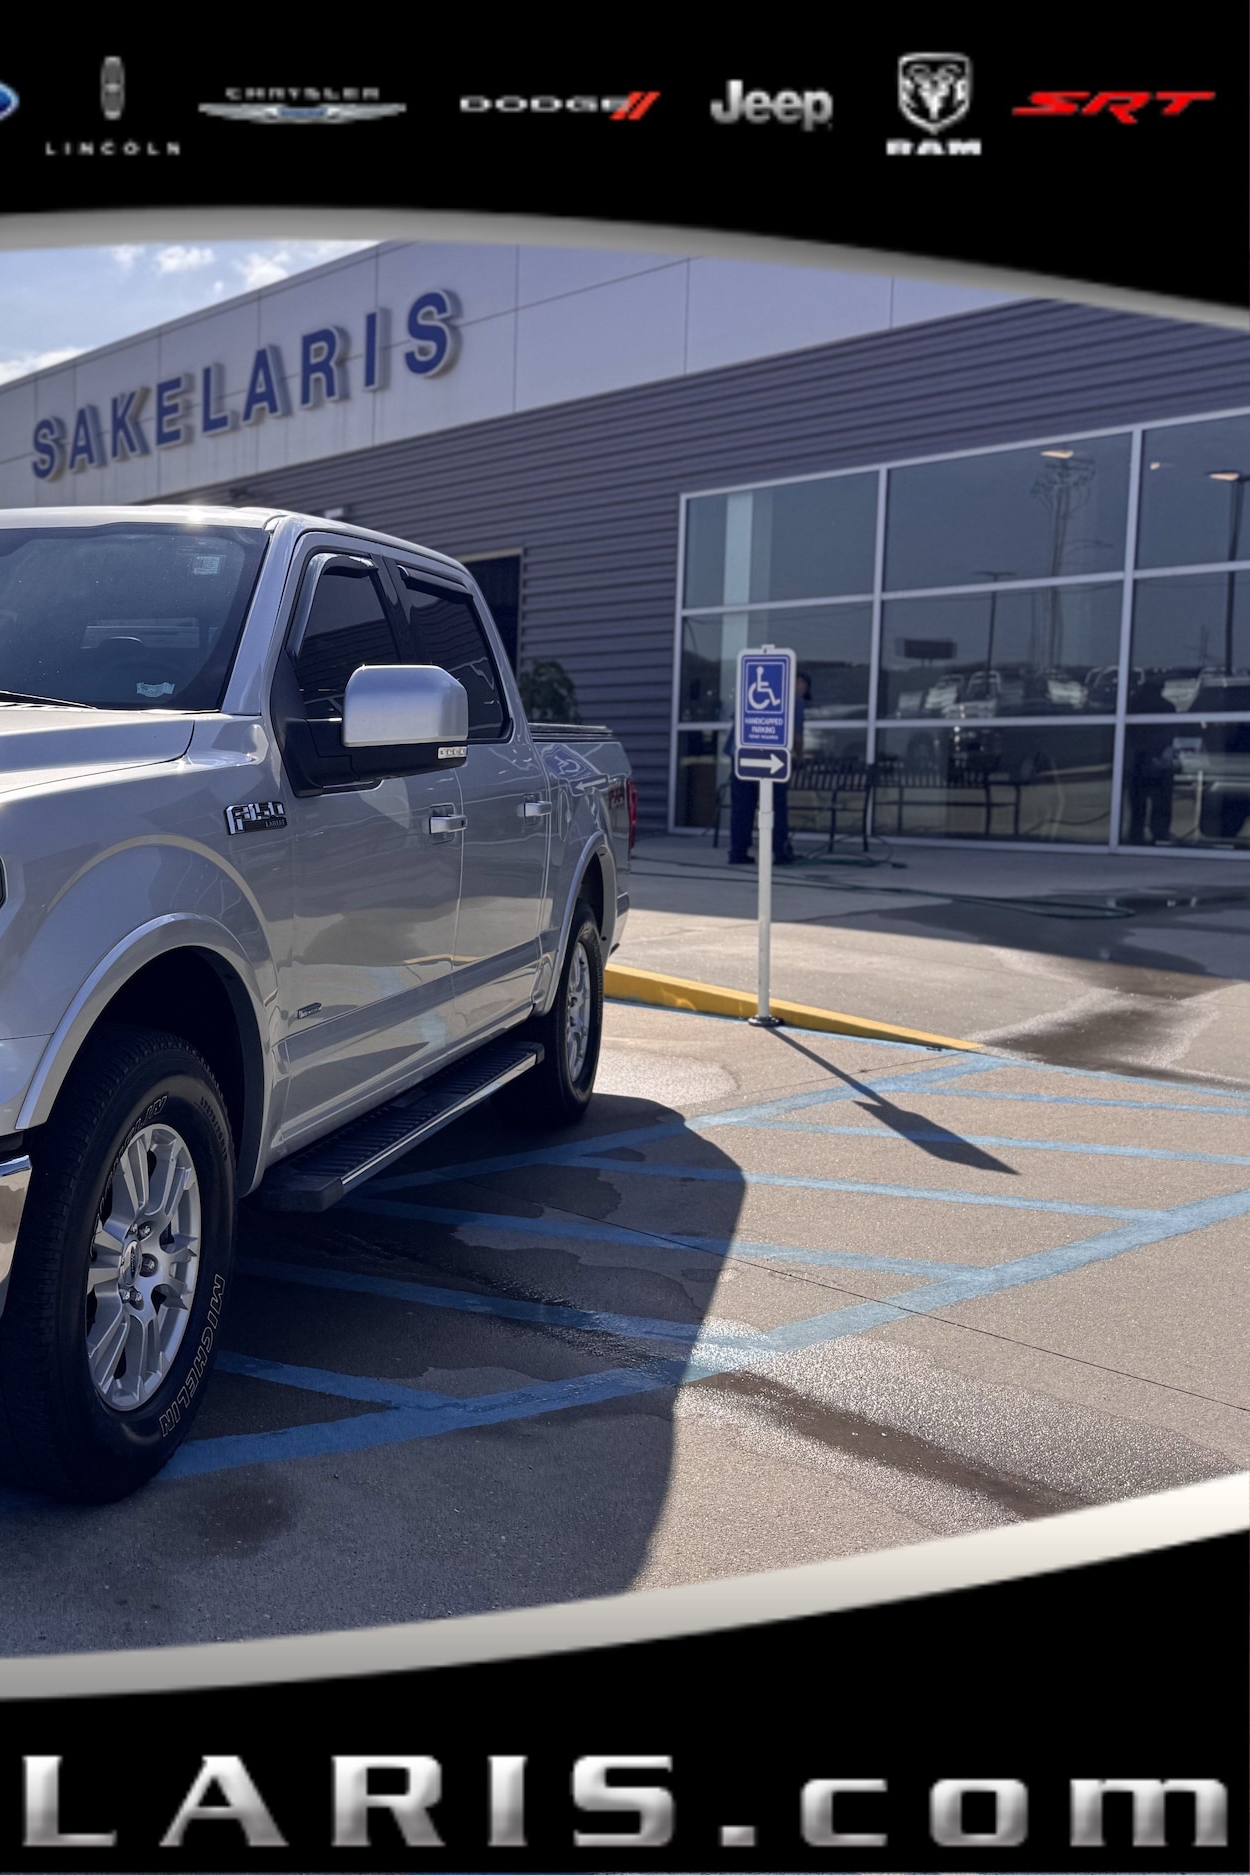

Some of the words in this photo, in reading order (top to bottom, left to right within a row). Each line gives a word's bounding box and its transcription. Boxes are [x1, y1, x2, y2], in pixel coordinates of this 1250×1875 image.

[32, 289, 460, 481] SAKELARIS
[745, 718, 783, 726] HANDICAPPED
[751, 726, 776, 734] PARKING
[159, 1274, 226, 1438] MICHELIN
